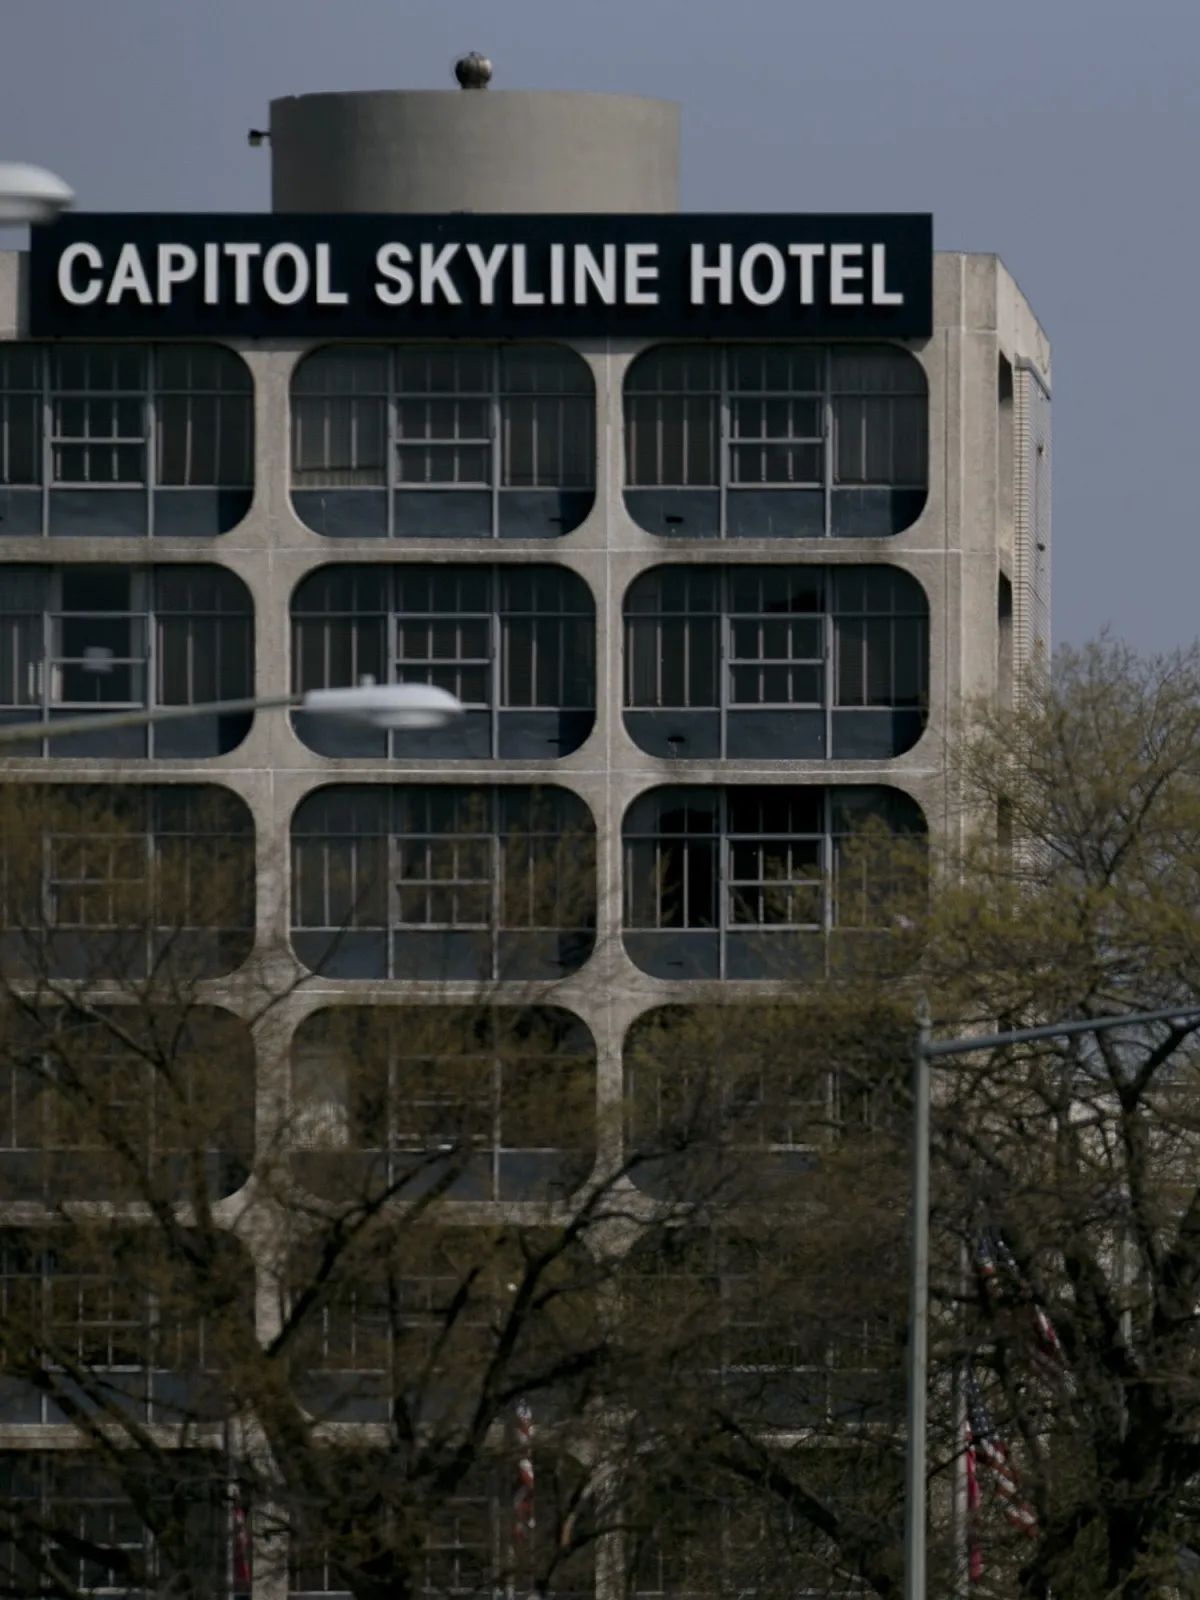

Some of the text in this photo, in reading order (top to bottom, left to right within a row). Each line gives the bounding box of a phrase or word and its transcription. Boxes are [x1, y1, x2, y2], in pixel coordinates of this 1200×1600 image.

[57, 242, 904, 305] CAPITOL SKYLINE HOTEL
